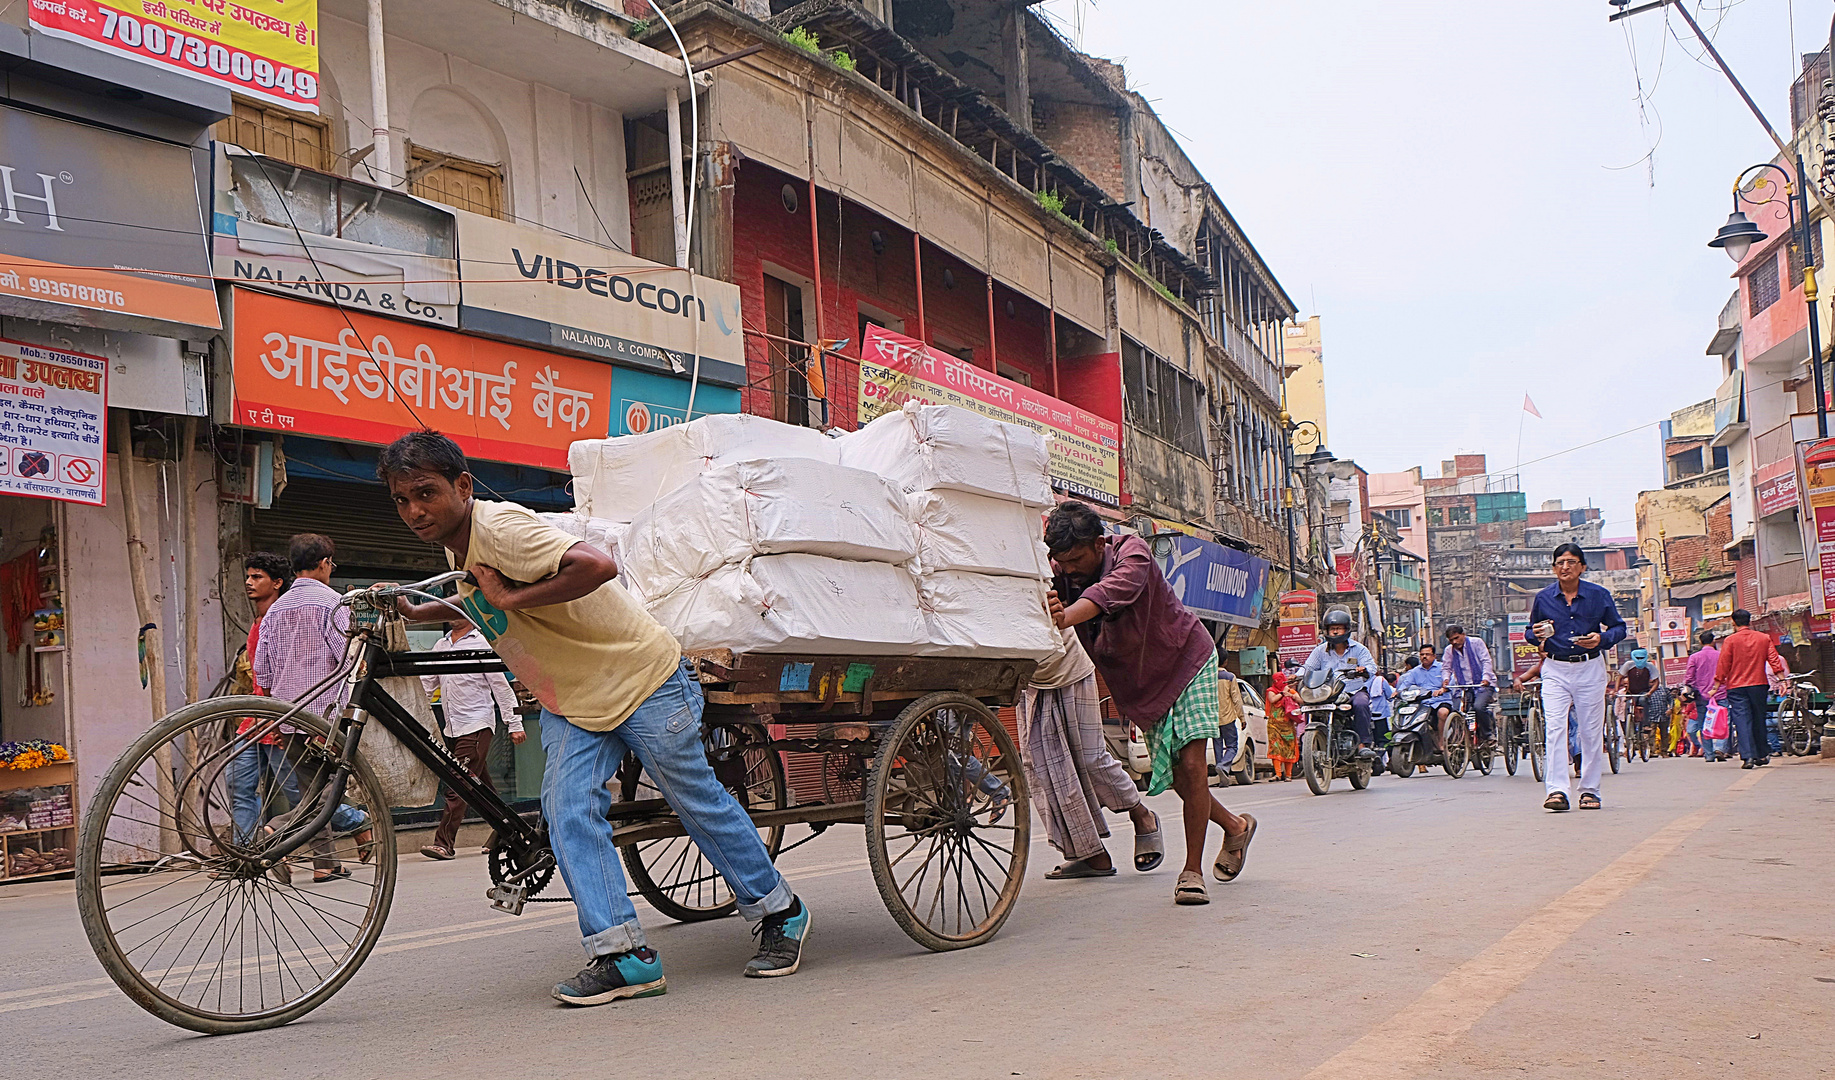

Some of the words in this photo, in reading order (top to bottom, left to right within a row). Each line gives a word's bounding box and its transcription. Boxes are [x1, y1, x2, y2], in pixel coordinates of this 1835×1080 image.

[142, 1, 167, 18] इसी
[170, 9, 207, 32] परिसर
[209, 21, 222, 36] में
[229, 3, 291, 38] उपलब्ध
[295, 21, 316, 46] है।
[98, 7, 318, 99] 7007300949
[0, 165, 64, 232] H
[30, 277, 125, 307] 9936787876
[233, 260, 372, 306] NALANDA
[379, 293, 397, 311] &
[404, 299, 443, 320] Co.
[561, 329, 612, 350] NALANDA
[618, 341, 625, 353] &
[20, 346, 46, 360] Mob.:
[49, 352, 104, 370] 9795501831
[22, 359, 103, 394] उपलब्ध
[260, 327, 517, 431] आईडीबीआई
[530, 365, 594, 432] बैंक
[0, 383, 20, 395] ला
[22, 386, 46, 399] वाले
[862, 364, 896, 382] दूरबीन
[966, 399, 976, 410] गले
[978, 403, 987, 413] का
[988, 406, 1012, 422] ऑपरेशन
[18, 400, 47, 414] कैमरा,
[248, 410, 257, 424] ए
[260, 408, 274, 424] टी
[277, 414, 294, 428] एम
[1051, 409, 1072, 427] वाराणसी
[4, 411, 41, 424] धार-धार
[44, 417, 79, 431] हथियार,
[82, 422, 99, 434] पेन,
[18, 423, 49, 436] सिगरेट
[51, 430, 79, 441] इत्यादि
[82, 435, 99, 444] चीजें
[1074, 424, 1090, 438] गला
[1092, 431, 1098, 440] व
[20, 435, 32, 446] है।
[1049, 429, 1097, 453] Diabetes
[1054, 442, 1104, 467] riyanka
[1099, 447, 1116, 459] शुगर
[1051, 468, 1068, 479] erpool
[1065, 457, 1091, 472] Fellowship
[1098, 468, 1117, 480] Diabetes
[16, 482, 21, 490] 4
[66, 488, 96, 499] वाराणसी
[1206, 562, 1249, 598] LUMINOUS
[428, 734, 469, 773] NEELAM
